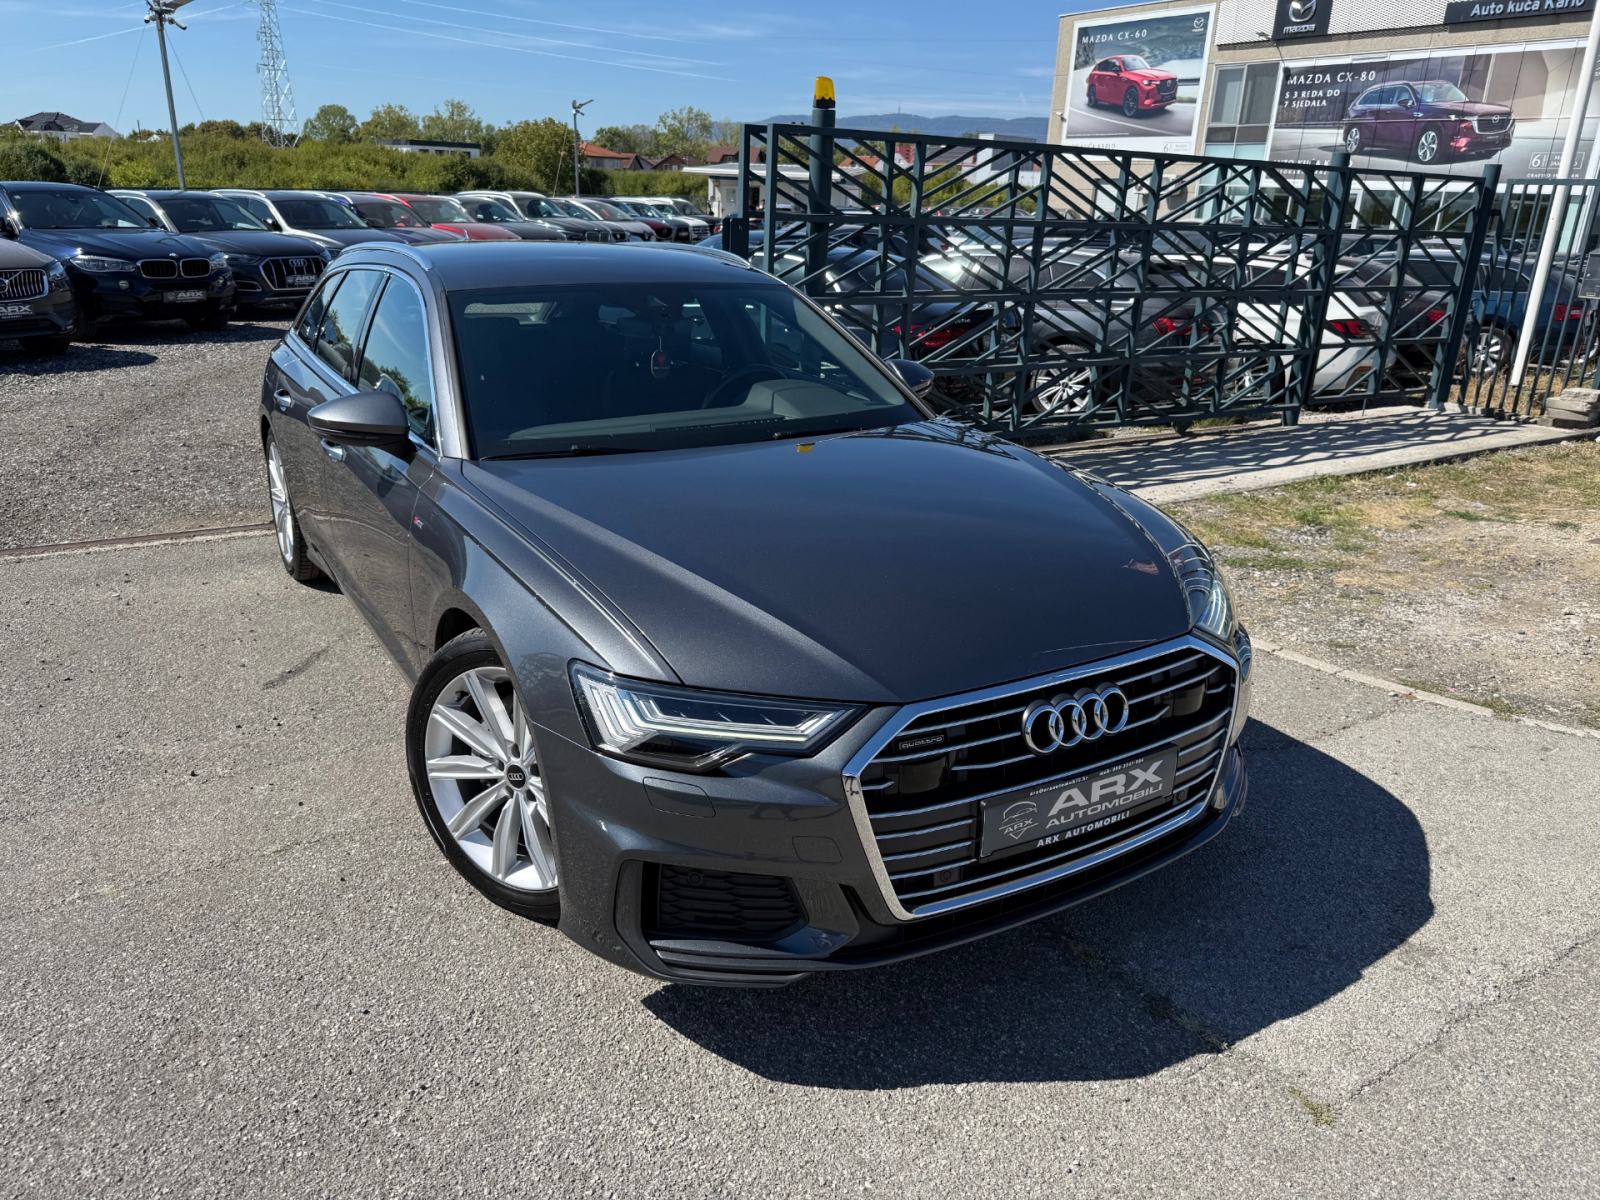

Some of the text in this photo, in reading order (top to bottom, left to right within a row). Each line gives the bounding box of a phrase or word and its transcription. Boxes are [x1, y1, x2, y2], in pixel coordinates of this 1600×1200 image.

[1470, 3, 1504, 17] Auto
[1082, 29, 1148, 44] MAZDA CX-60
[1283, 24, 1316, 35] mazda
[1287, 70, 1376, 85] MAZDA CX-80
[1293, 91, 1298, 99] 3
[1301, 89, 1323, 98] REDA
[1327, 89, 1341, 97] DO
[1292, 99, 1327, 109] SJEDALA
[1531, 154, 1541, 168] 6
[1047, 759, 1164, 817] ARX
[1045, 783, 1163, 829] AUTOMOBILI
[1003, 817, 1034, 835] ARX
[1036, 810, 1131, 848] ARX AUTOMOBILI
